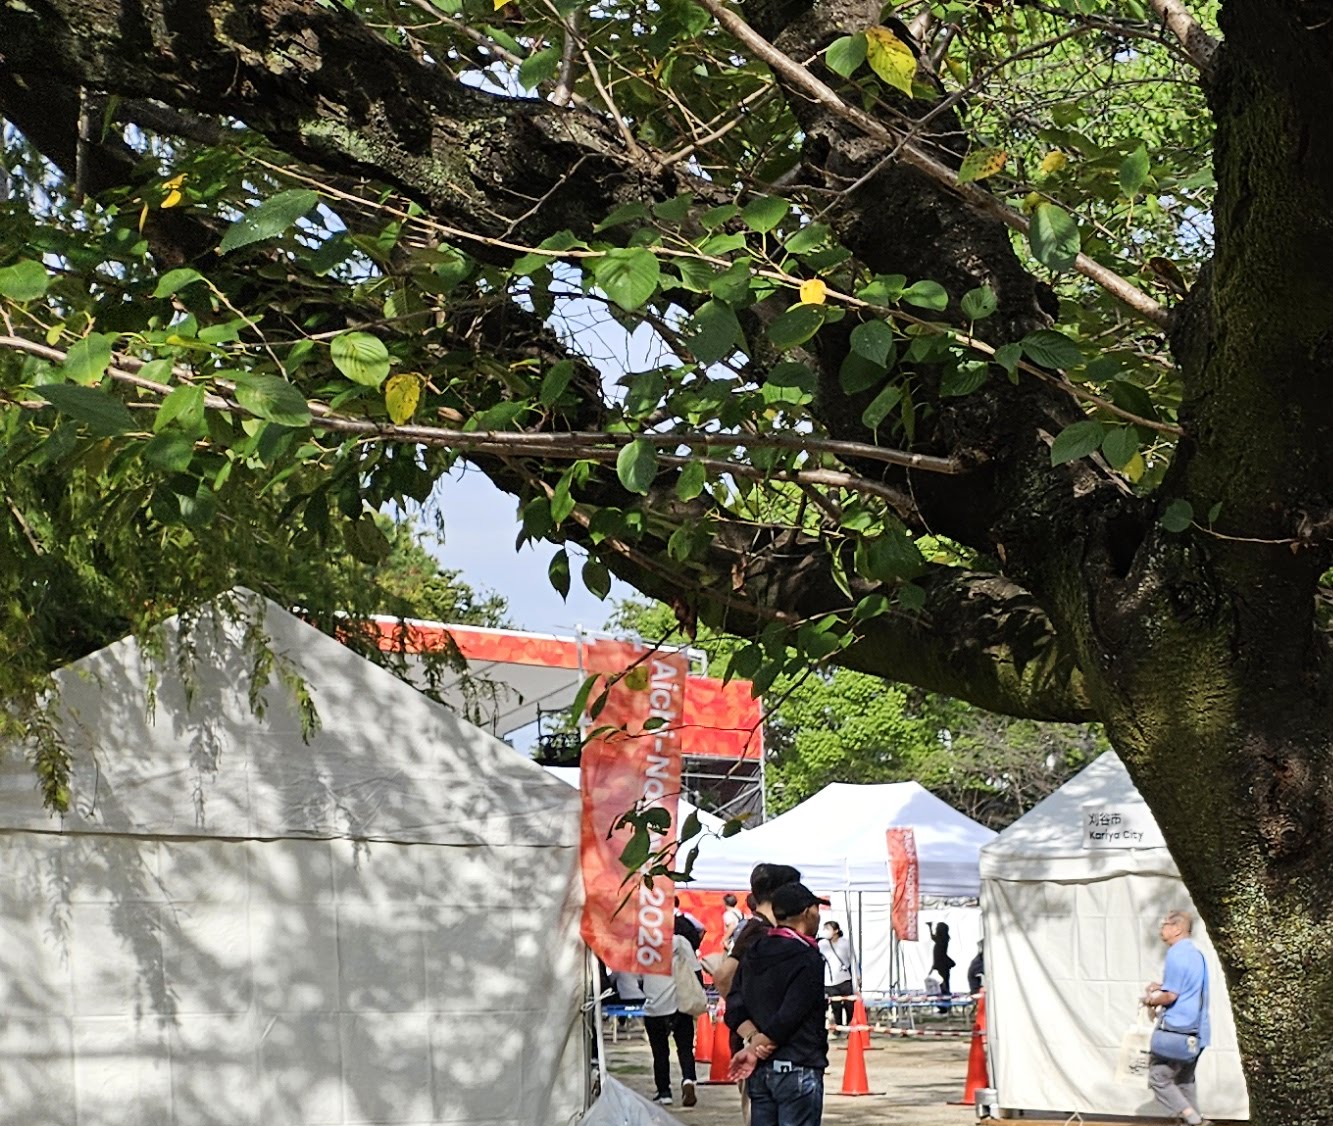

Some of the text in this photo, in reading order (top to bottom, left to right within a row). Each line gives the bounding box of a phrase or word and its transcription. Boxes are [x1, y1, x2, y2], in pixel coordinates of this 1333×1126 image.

[1088, 813, 1122, 826] 刈谷市
[1089, 828, 1144, 842] Kariya City
[636, 886, 665, 967] 2026
